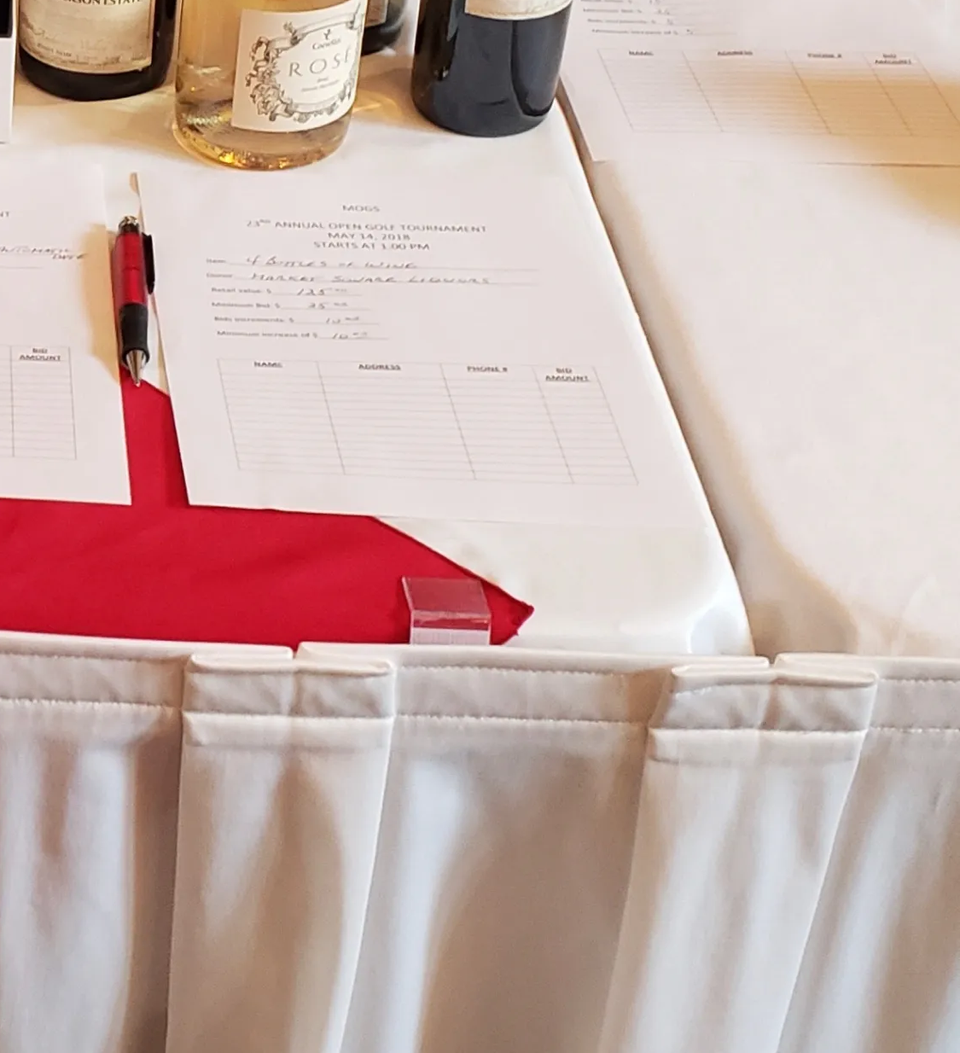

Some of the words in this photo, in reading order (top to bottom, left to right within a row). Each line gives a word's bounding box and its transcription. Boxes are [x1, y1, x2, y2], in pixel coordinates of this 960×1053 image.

[342, 204, 381, 213] MOGS
[274, 220, 325, 230] ANNUAL
[328, 221, 362, 231] OPEN
[365, 223, 395, 232] GOLF
[400, 223, 486, 234] TOURNAMENT
[327, 231, 355, 240] MAY
[381, 233, 411, 241] 2018
[313, 240, 359, 249] STARTS
[361, 241, 376, 250] AT
[410, 242, 431, 251] PM
[19, 353, 62, 362] AMOUNT
[253, 360, 284, 369] NAME
[357, 363, 401, 372] ADDRESS
[545, 374, 591, 383] AMOUNT
